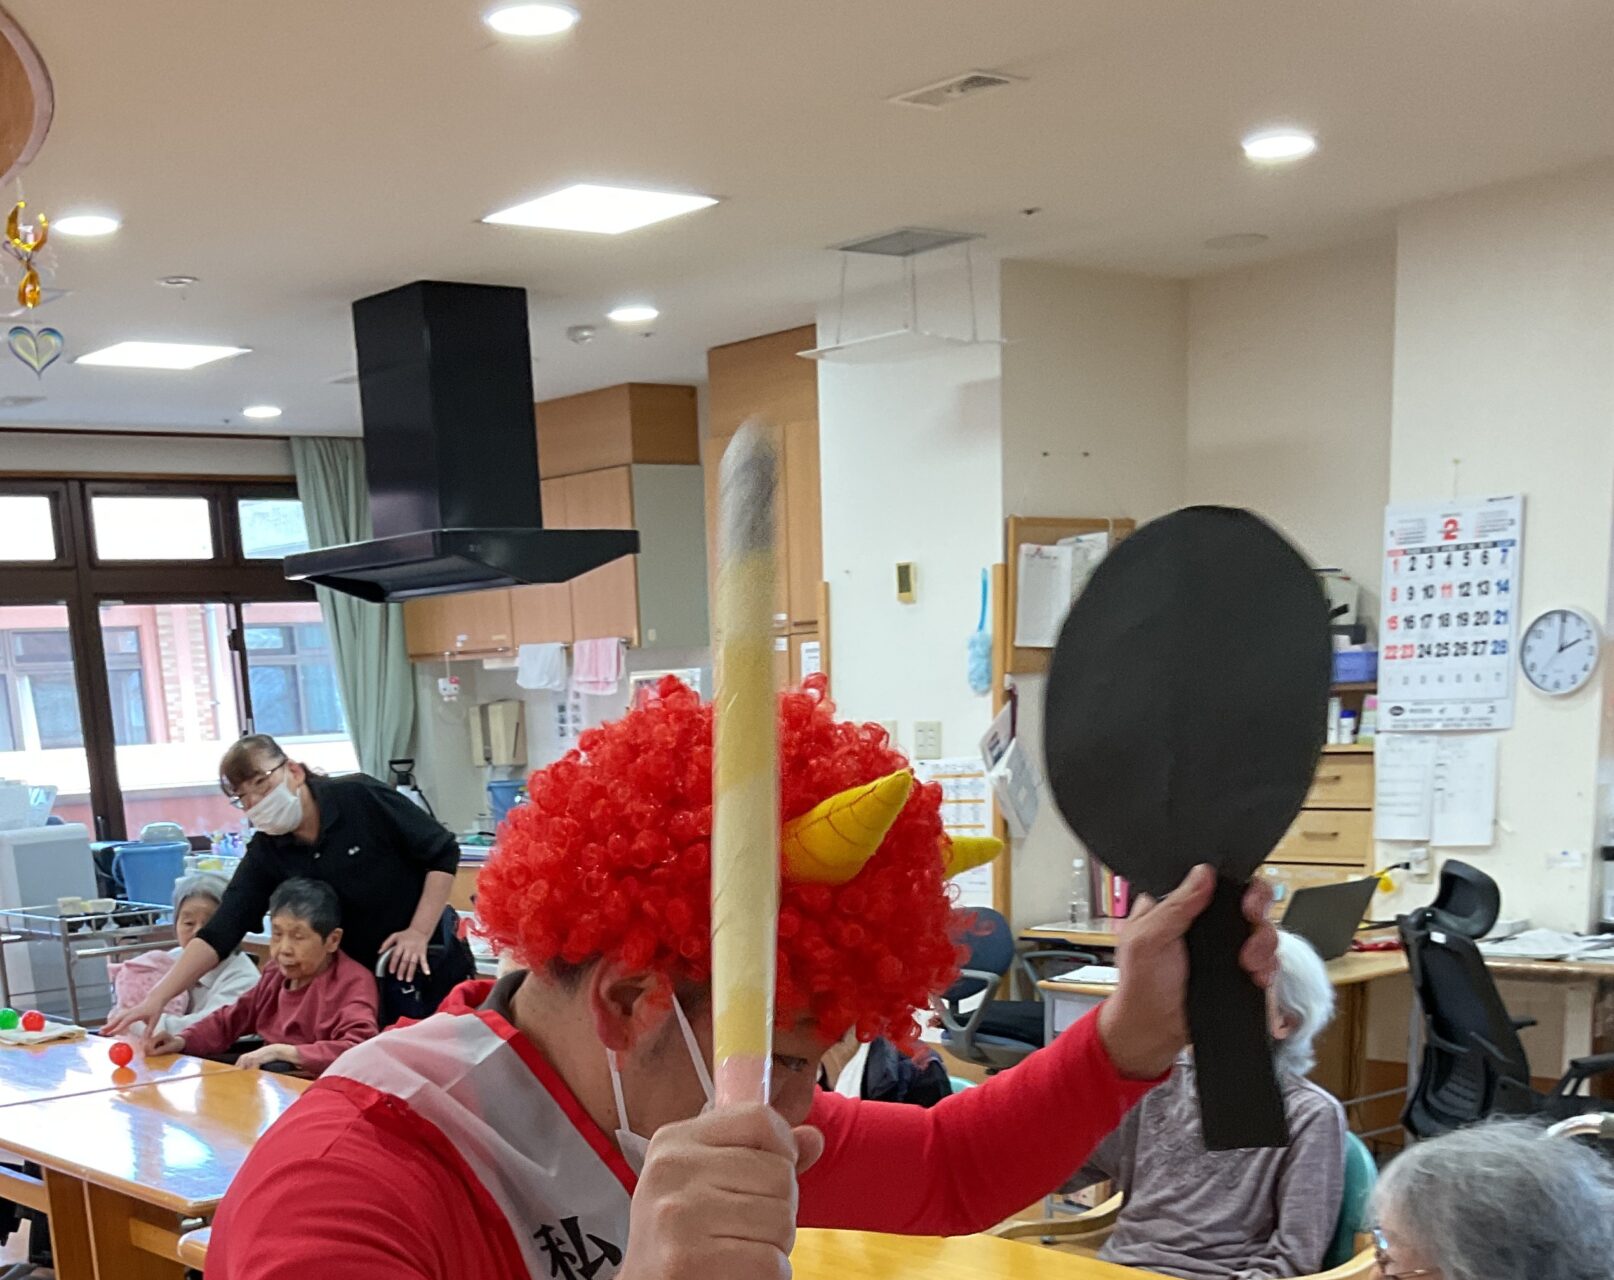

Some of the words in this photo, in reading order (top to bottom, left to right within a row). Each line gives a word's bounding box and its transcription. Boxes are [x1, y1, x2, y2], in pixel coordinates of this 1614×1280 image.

[1443, 518, 1458, 540] 2
[1393, 558, 1399, 573] 1
[1408, 556, 1416, 571] 2
[1426, 555, 1434, 569] 3
[1444, 553, 1452, 568] 4
[1463, 551, 1471, 567] 5
[1481, 550, 1489, 565] 6
[1501, 548, 1509, 565] 7
[1391, 587, 1397, 602] 8
[1407, 586, 1415, 600] 9
[1422, 584, 1435, 600] 10
[1441, 583, 1453, 598] 11
[1458, 582, 1471, 597] 12
[1477, 580, 1490, 595] 13
[1496, 578, 1509, 595] 14
[1387, 615, 1398, 630] 15
[1403, 615, 1415, 630] 16
[1420, 613, 1433, 629] 17
[1438, 612, 1451, 627] 18
[1456, 612, 1469, 627] 19
[1473, 610, 1490, 626] 20
[1493, 609, 1508, 625] 21
[1384, 645, 1398, 659] 22
[1400, 644, 1415, 659] 23
[1417, 643, 1432, 658] 24
[1435, 642, 1450, 657] 25
[1453, 641, 1468, 656] 26
[1471, 640, 1489, 656] 27
[1490, 639, 1509, 655] 28
